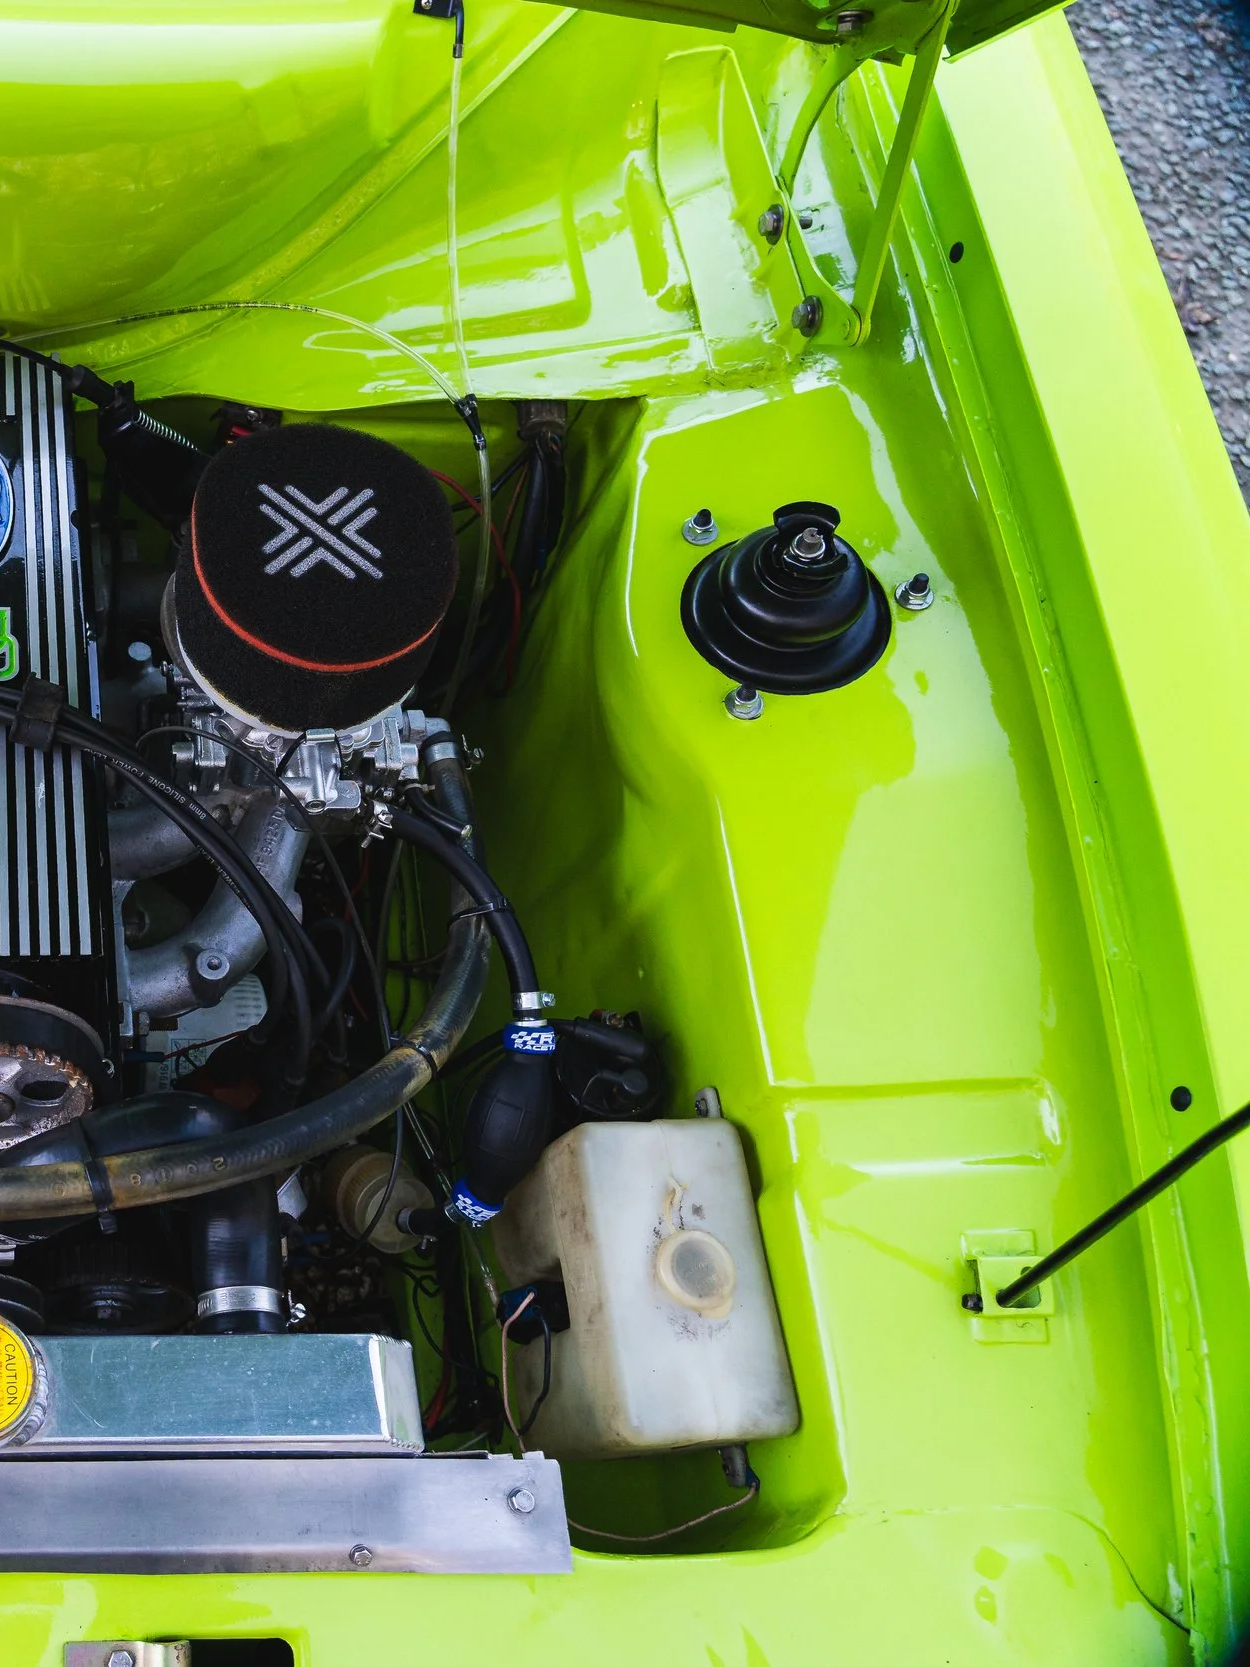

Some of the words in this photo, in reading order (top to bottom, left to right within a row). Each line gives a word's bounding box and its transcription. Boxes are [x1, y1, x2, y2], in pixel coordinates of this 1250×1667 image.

[148, 776, 186, 804] SILICONE
[189, 802, 207, 820] 8mm
[4, 1343, 18, 1406] CAUTION
